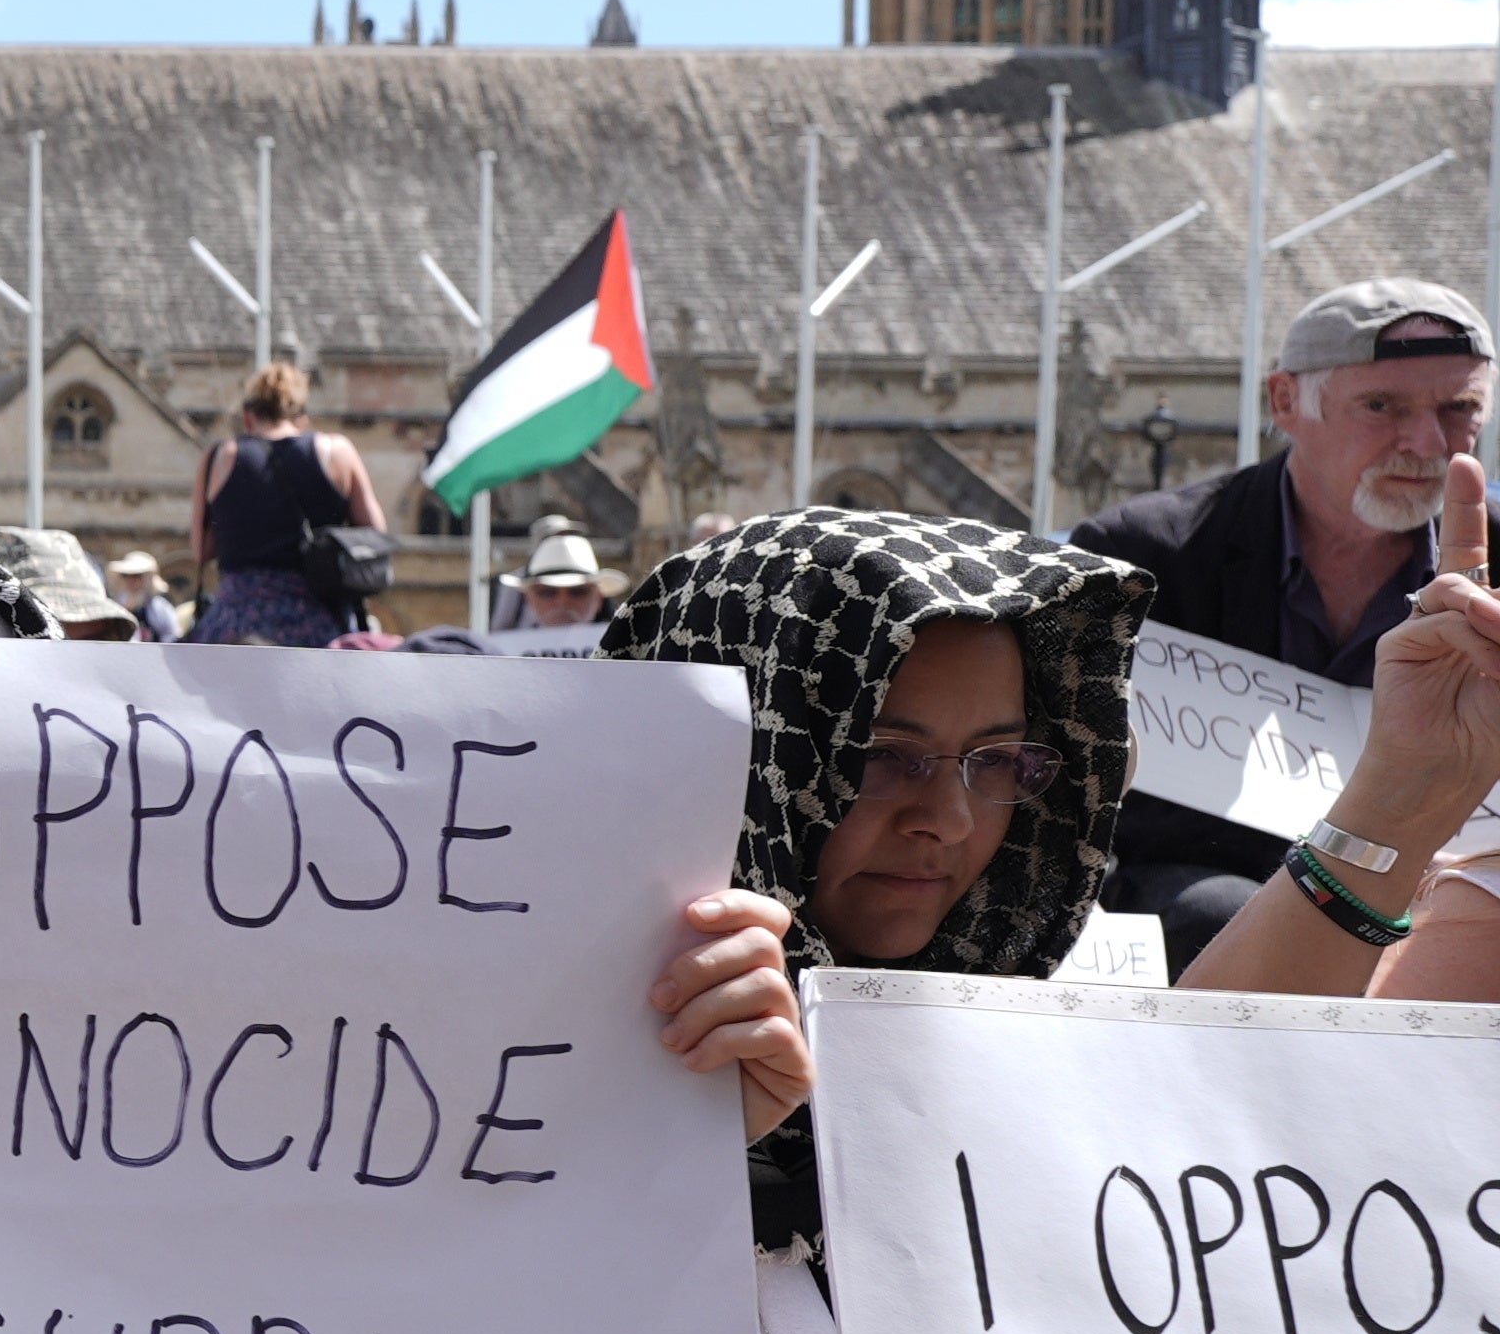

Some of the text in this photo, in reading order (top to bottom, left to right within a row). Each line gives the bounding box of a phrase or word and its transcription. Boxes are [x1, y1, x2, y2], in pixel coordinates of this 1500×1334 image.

[1135, 636, 1327, 724] OPPOSE
[1135, 690, 1346, 793] NOCIDE
[956, 1150, 995, 1333] I
